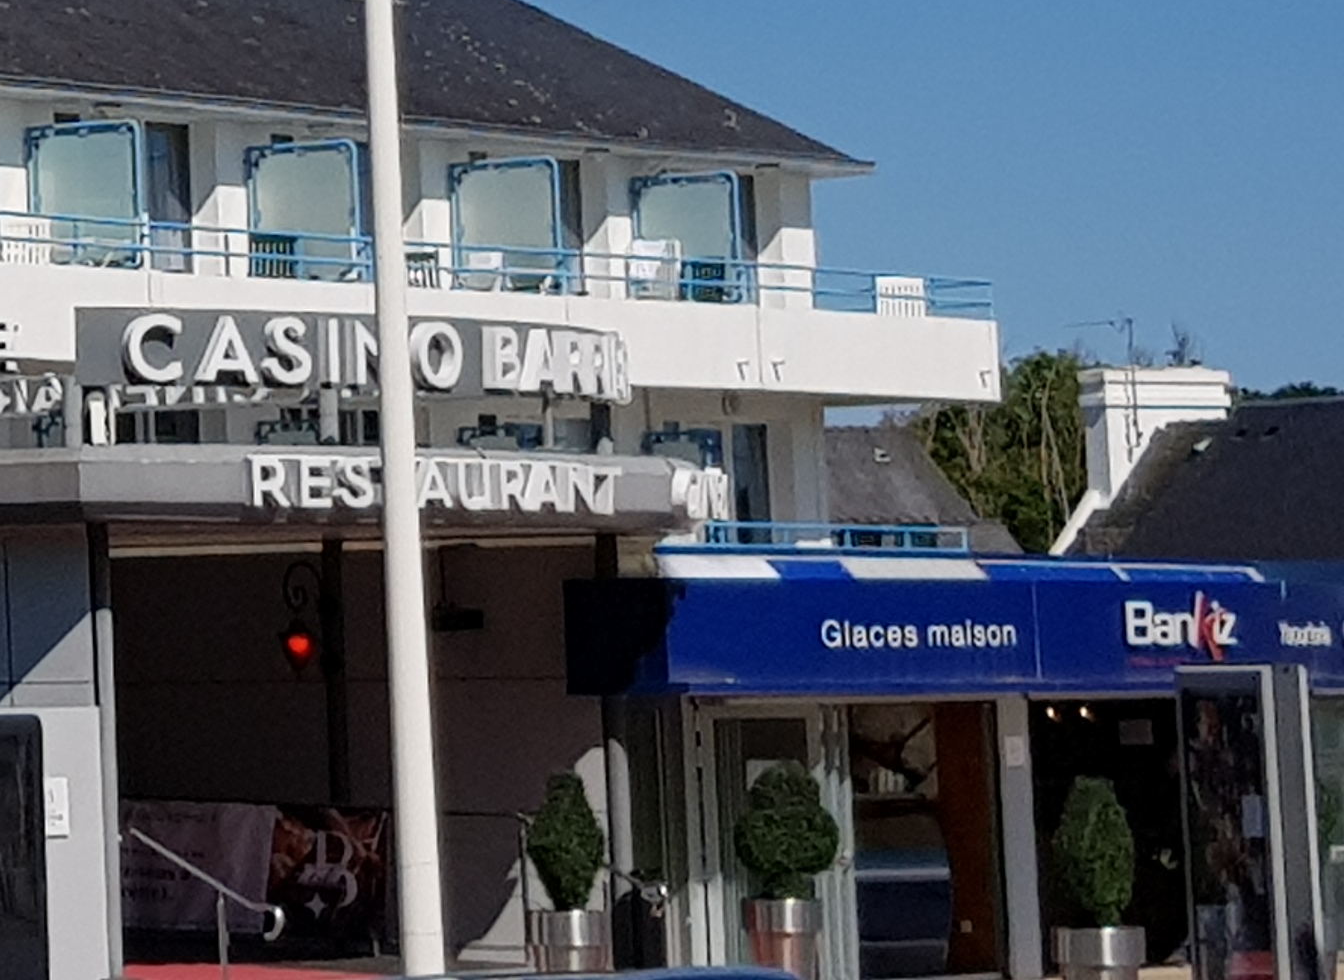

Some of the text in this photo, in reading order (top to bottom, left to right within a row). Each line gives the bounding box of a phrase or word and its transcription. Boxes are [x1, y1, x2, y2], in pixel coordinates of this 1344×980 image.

[249, 454, 623, 515] RESAURANT
[821, 618, 1017, 649] Glaces maison
